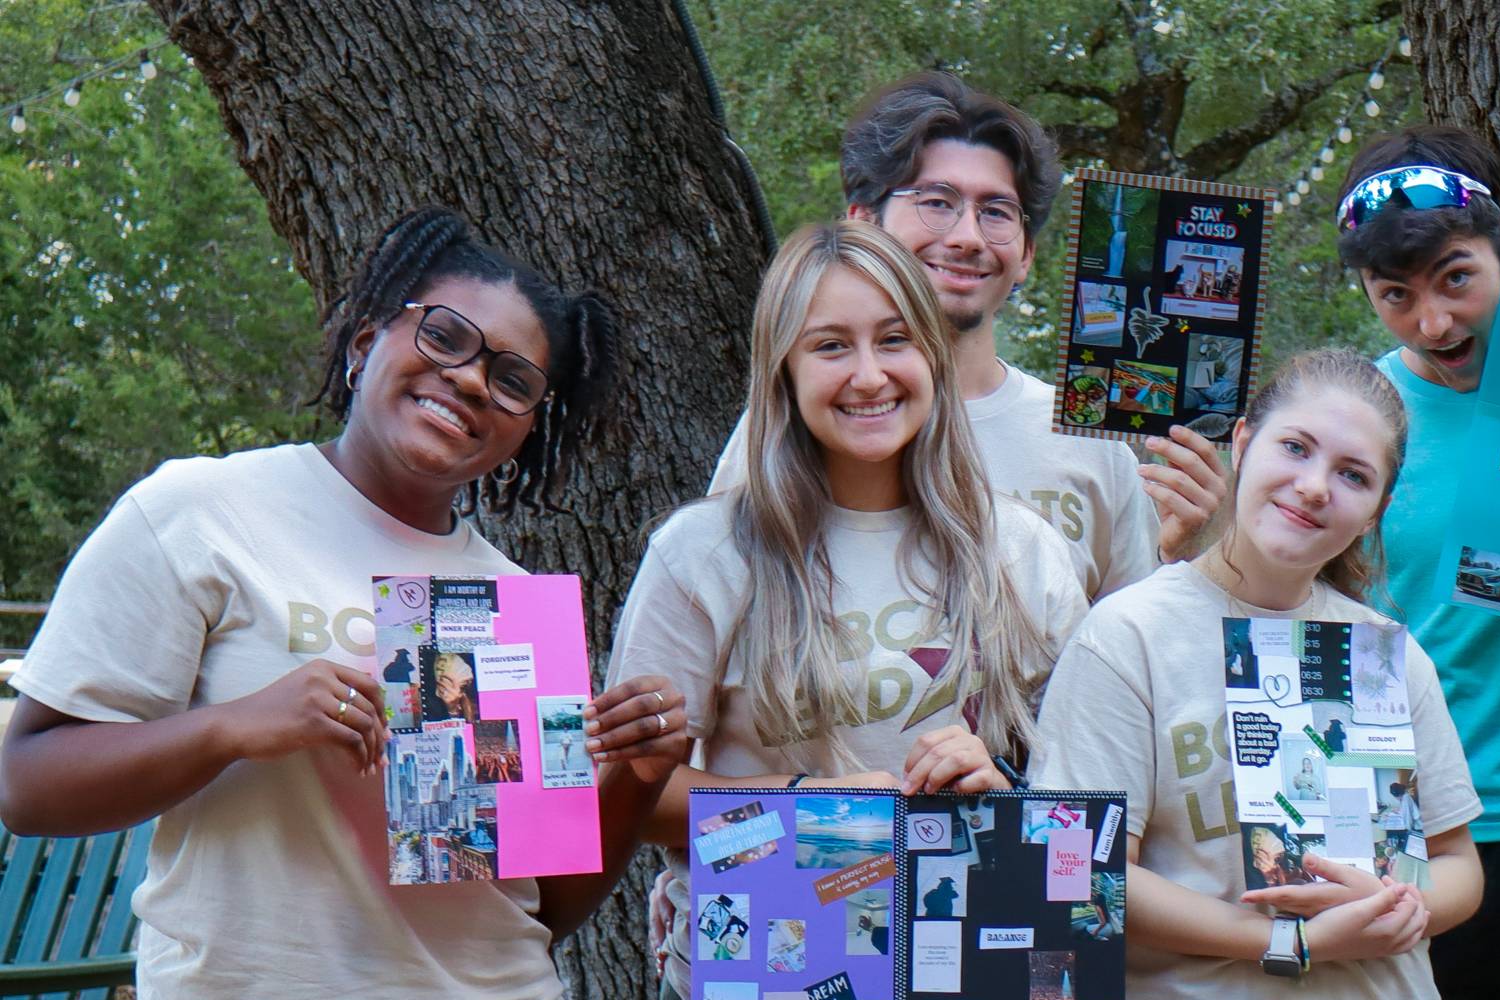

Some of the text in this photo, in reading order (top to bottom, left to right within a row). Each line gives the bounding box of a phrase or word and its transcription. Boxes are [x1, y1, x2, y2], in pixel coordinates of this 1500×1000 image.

[1190, 206, 1224, 222] STAY
[1176, 218, 1240, 240] FOCUSED
[480, 655, 530, 663] FORGIVENESS
[1235, 714, 1254, 723] Don't
[1241, 723, 1260, 731] good
[1260, 724, 1280, 733] today
[1246, 731, 1273, 740] thinking
[1237, 739, 1258, 747] about
[1056, 850, 1080, 859] love
[1060, 859, 1087, 869] your
[986, 933, 1028, 942] BALANCE
